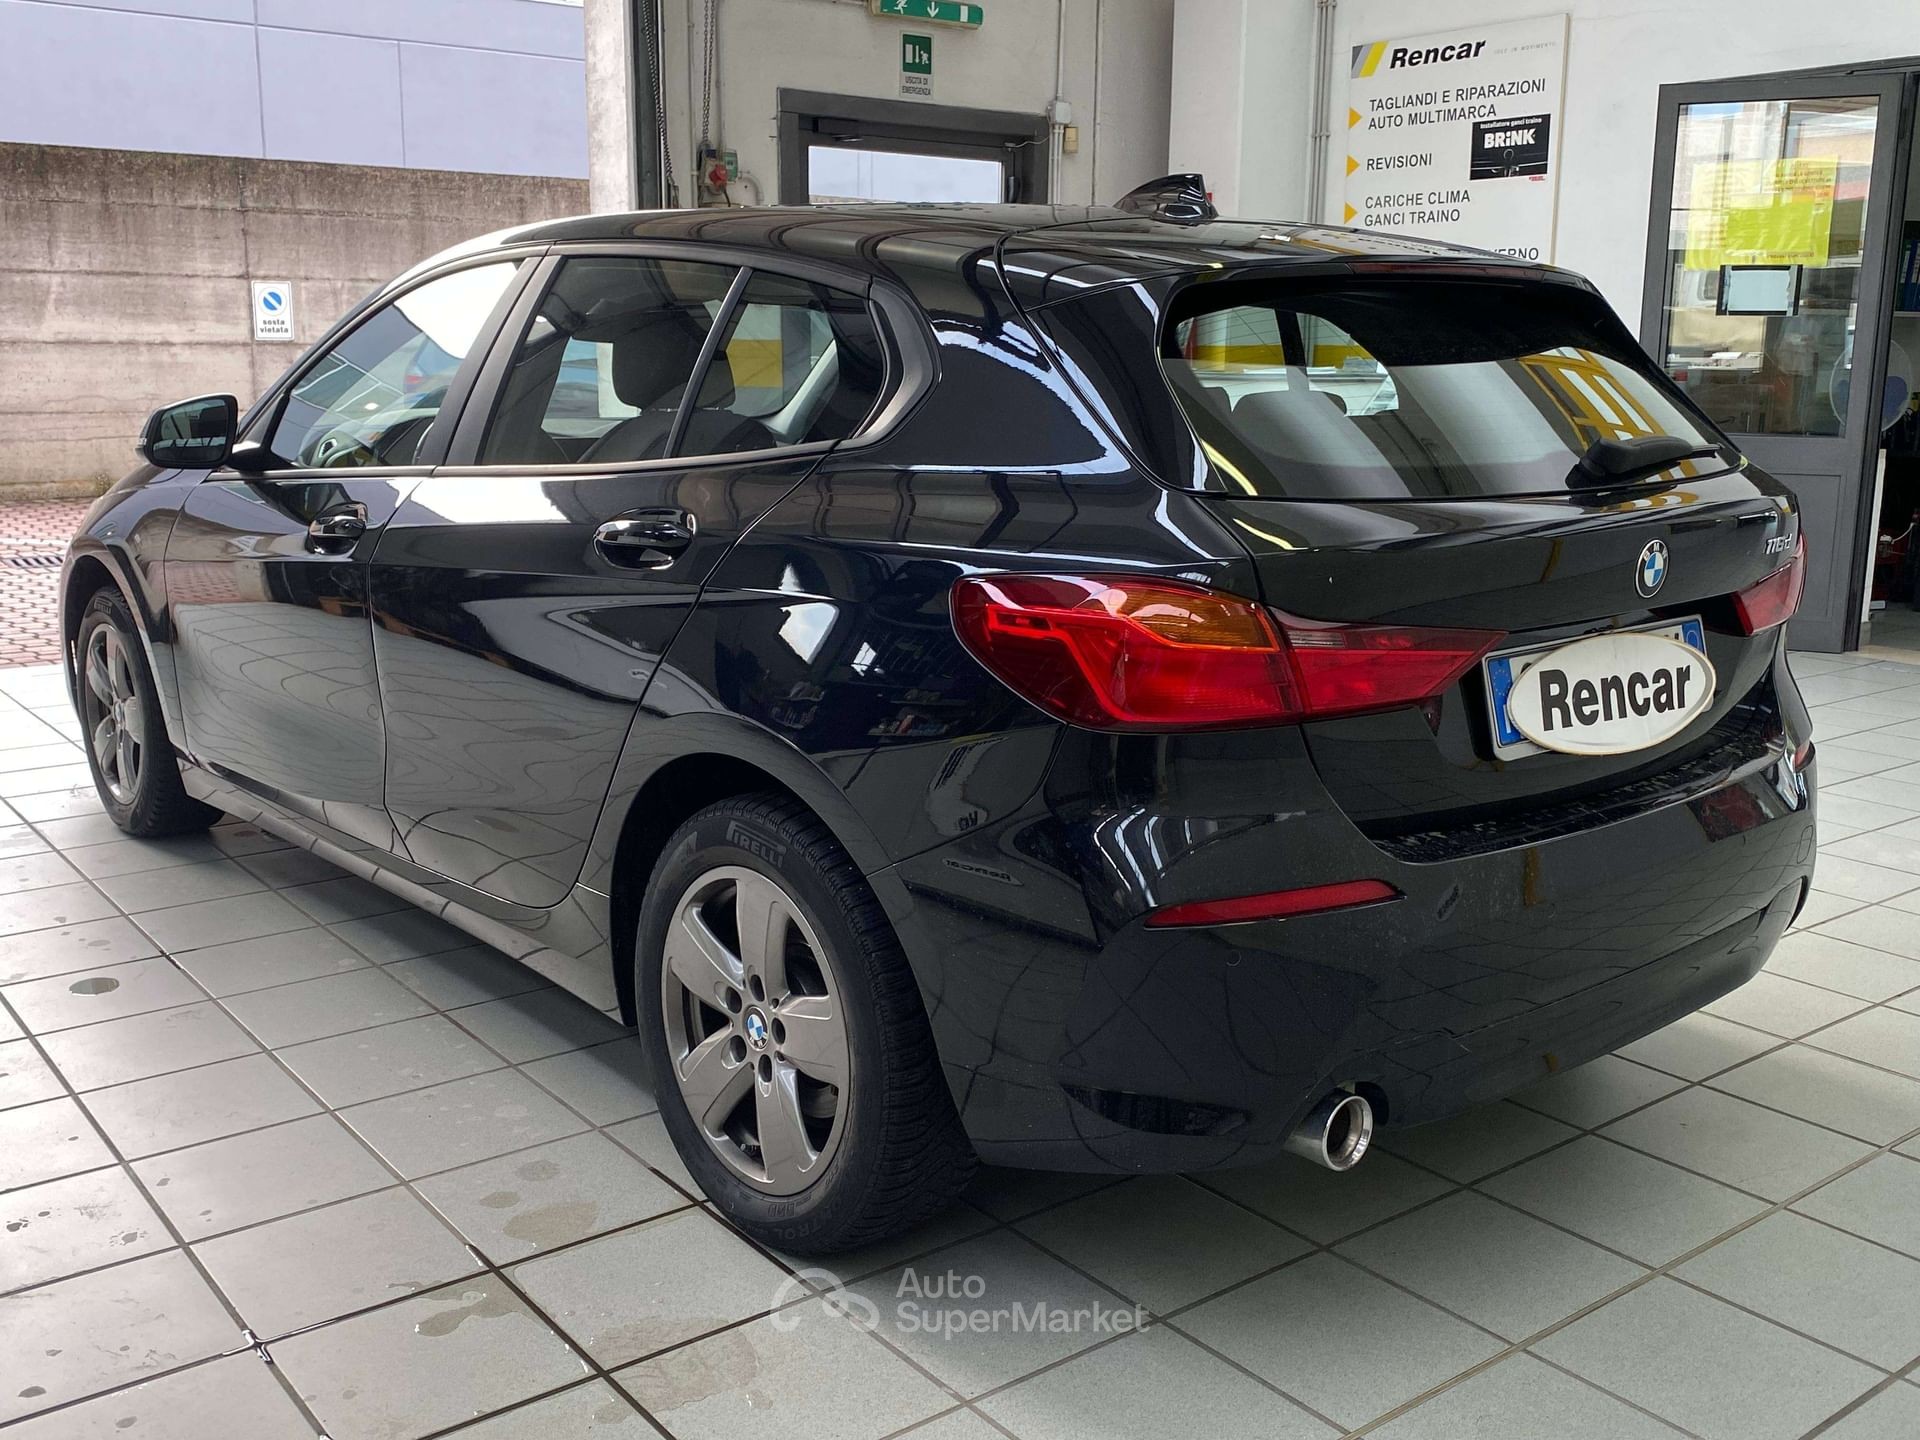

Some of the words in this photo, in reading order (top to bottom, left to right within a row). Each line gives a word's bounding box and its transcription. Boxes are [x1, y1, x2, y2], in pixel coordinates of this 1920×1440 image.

[1389, 39, 1487, 69] Rencar
[1369, 91, 1438, 112] TAGLIANDI
[1442, 89, 1451, 104] E
[1455, 78, 1546, 102] RIPARAZIONI
[1368, 114, 1404, 131] AUTO
[1407, 103, 1498, 127] MULTIMARCA
[1366, 152, 1433, 171] REVISIONI
[1364, 191, 1424, 210] CARICHE
[1427, 189, 1471, 206] CLIMA
[1364, 211, 1405, 227] GANCI
[1409, 208, 1461, 224] TRAINO
[1538, 663, 1692, 733] Rencar
[725, 819, 787, 868] PIRELLI
